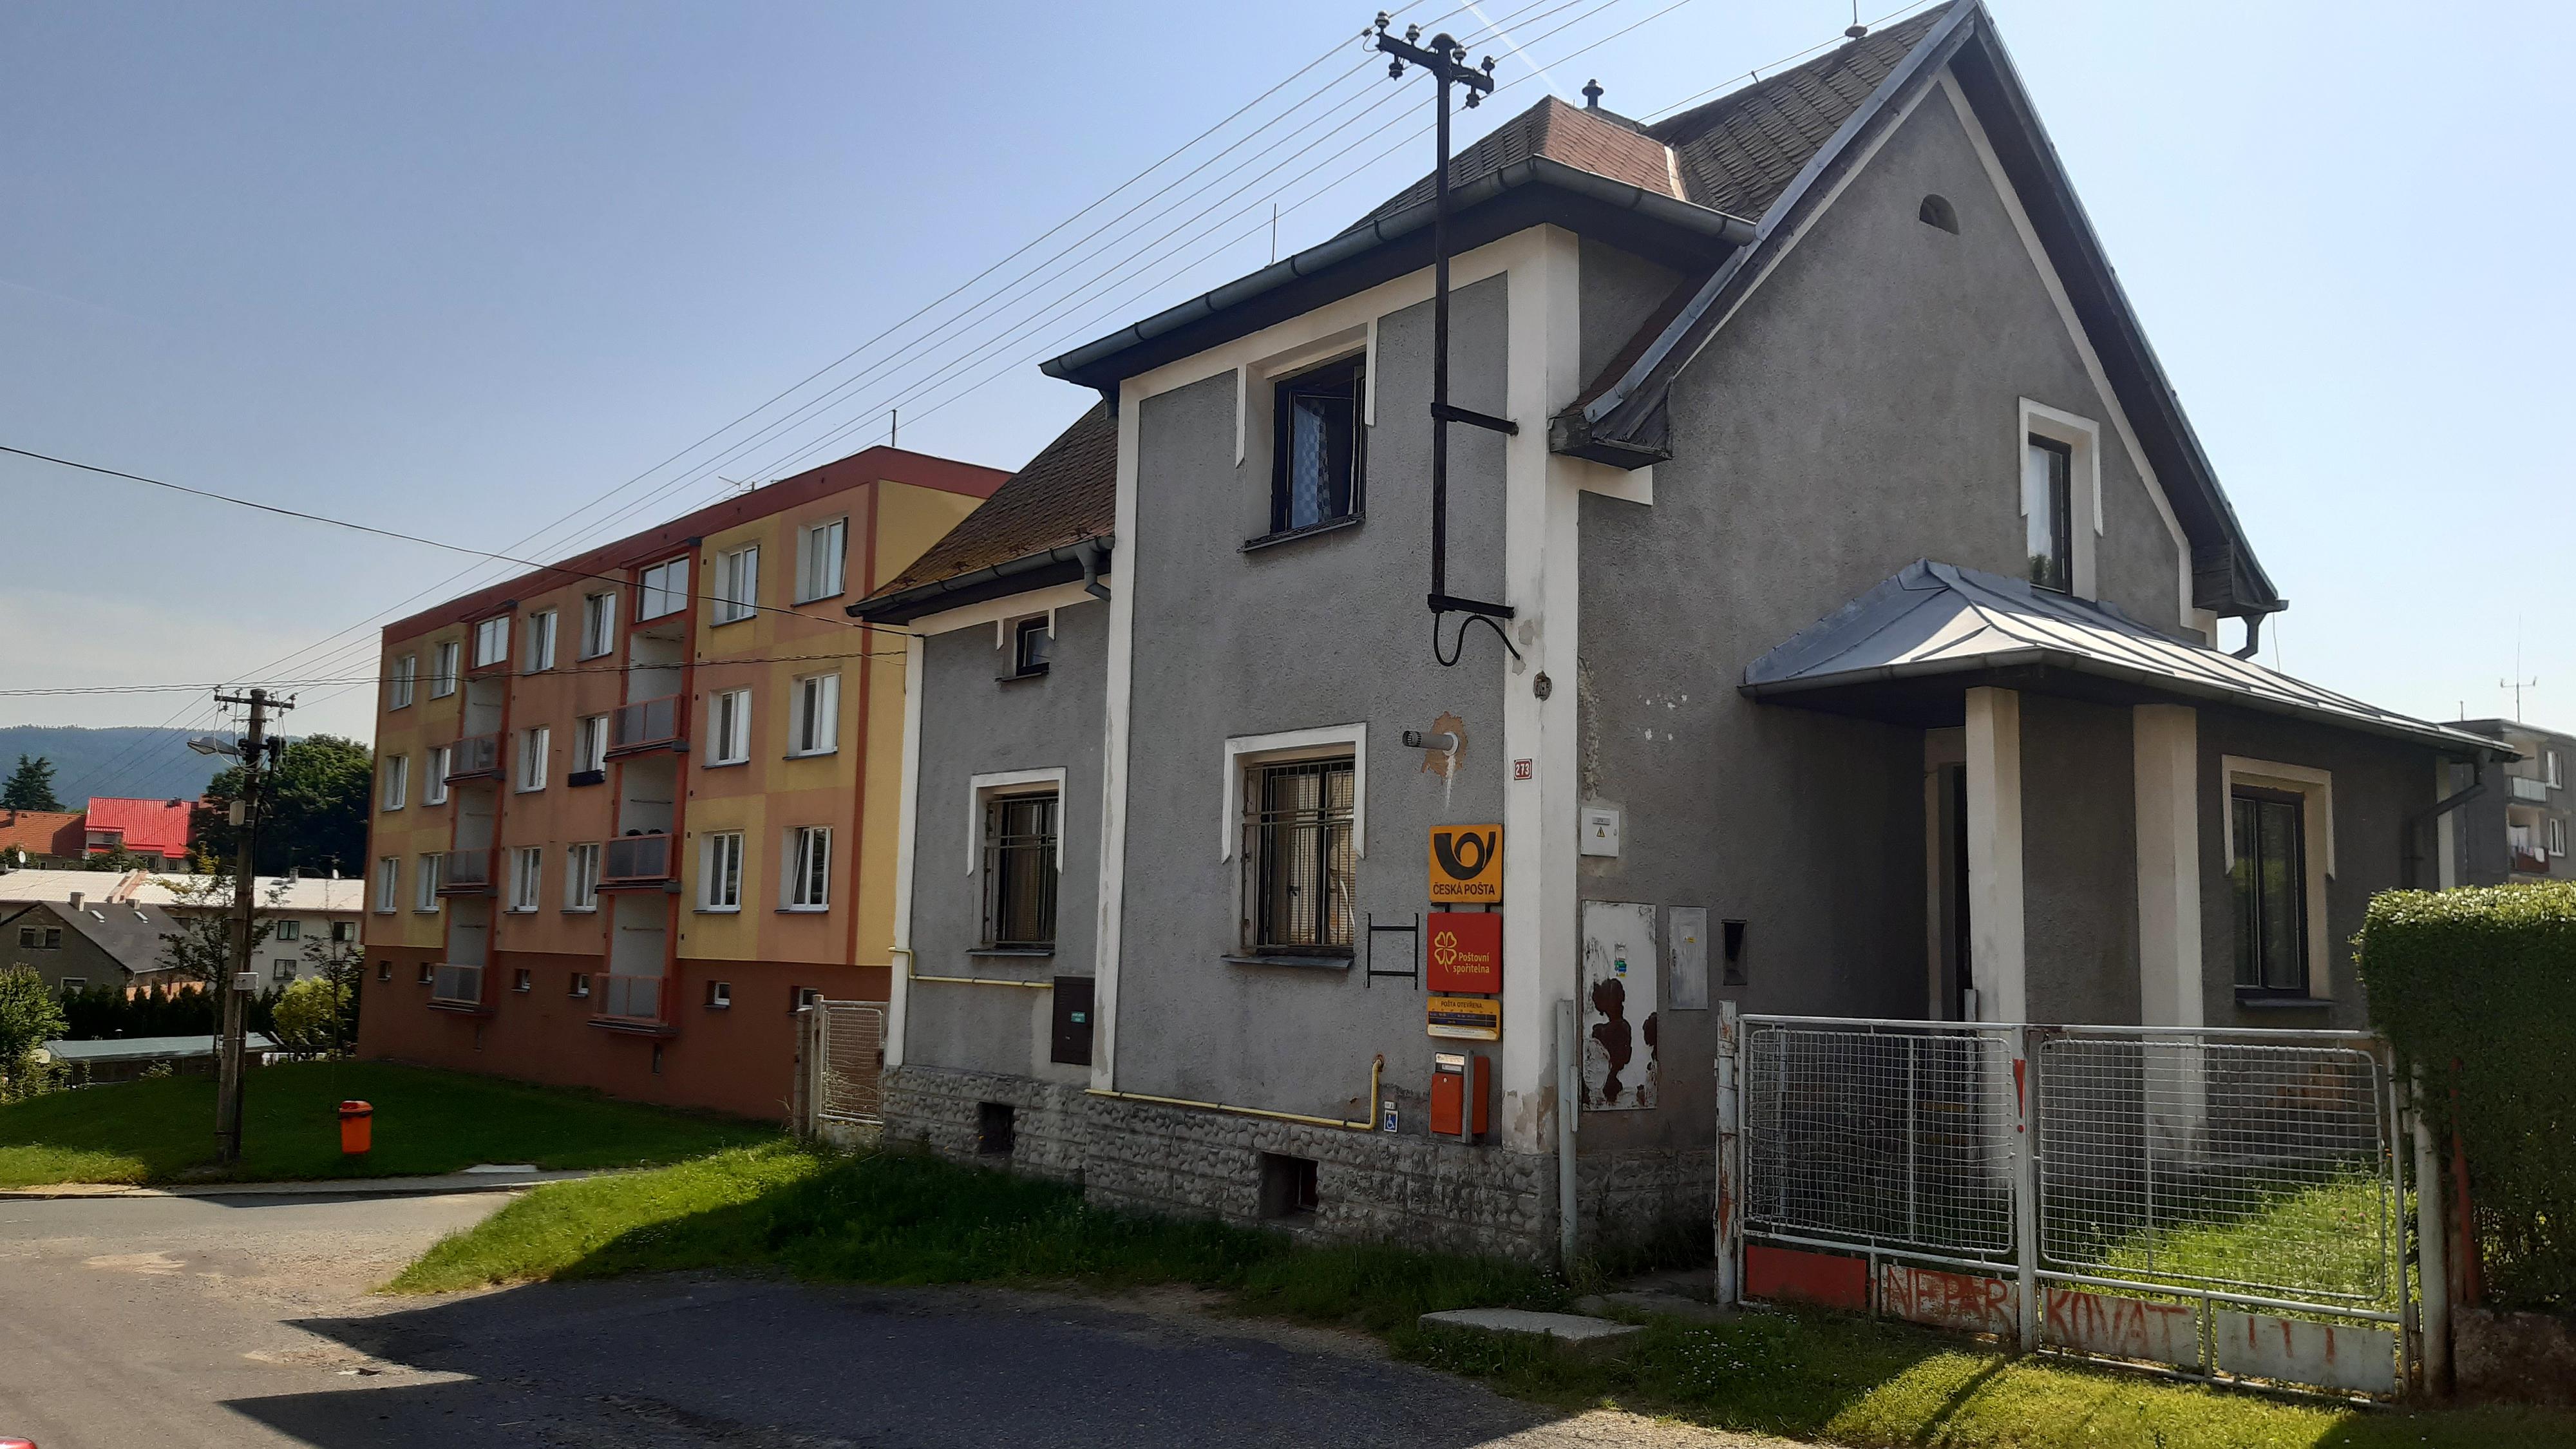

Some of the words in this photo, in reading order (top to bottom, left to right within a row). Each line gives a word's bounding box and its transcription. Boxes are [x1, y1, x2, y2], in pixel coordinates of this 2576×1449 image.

[1515, 763, 1530, 775] 273
[1433, 882, 1463, 895] ČESKÁ
[1464, 882, 1495, 895] POŠTA
[1459, 952, 1490, 962] Poštovní
[1453, 963, 1490, 974] spořitelna
